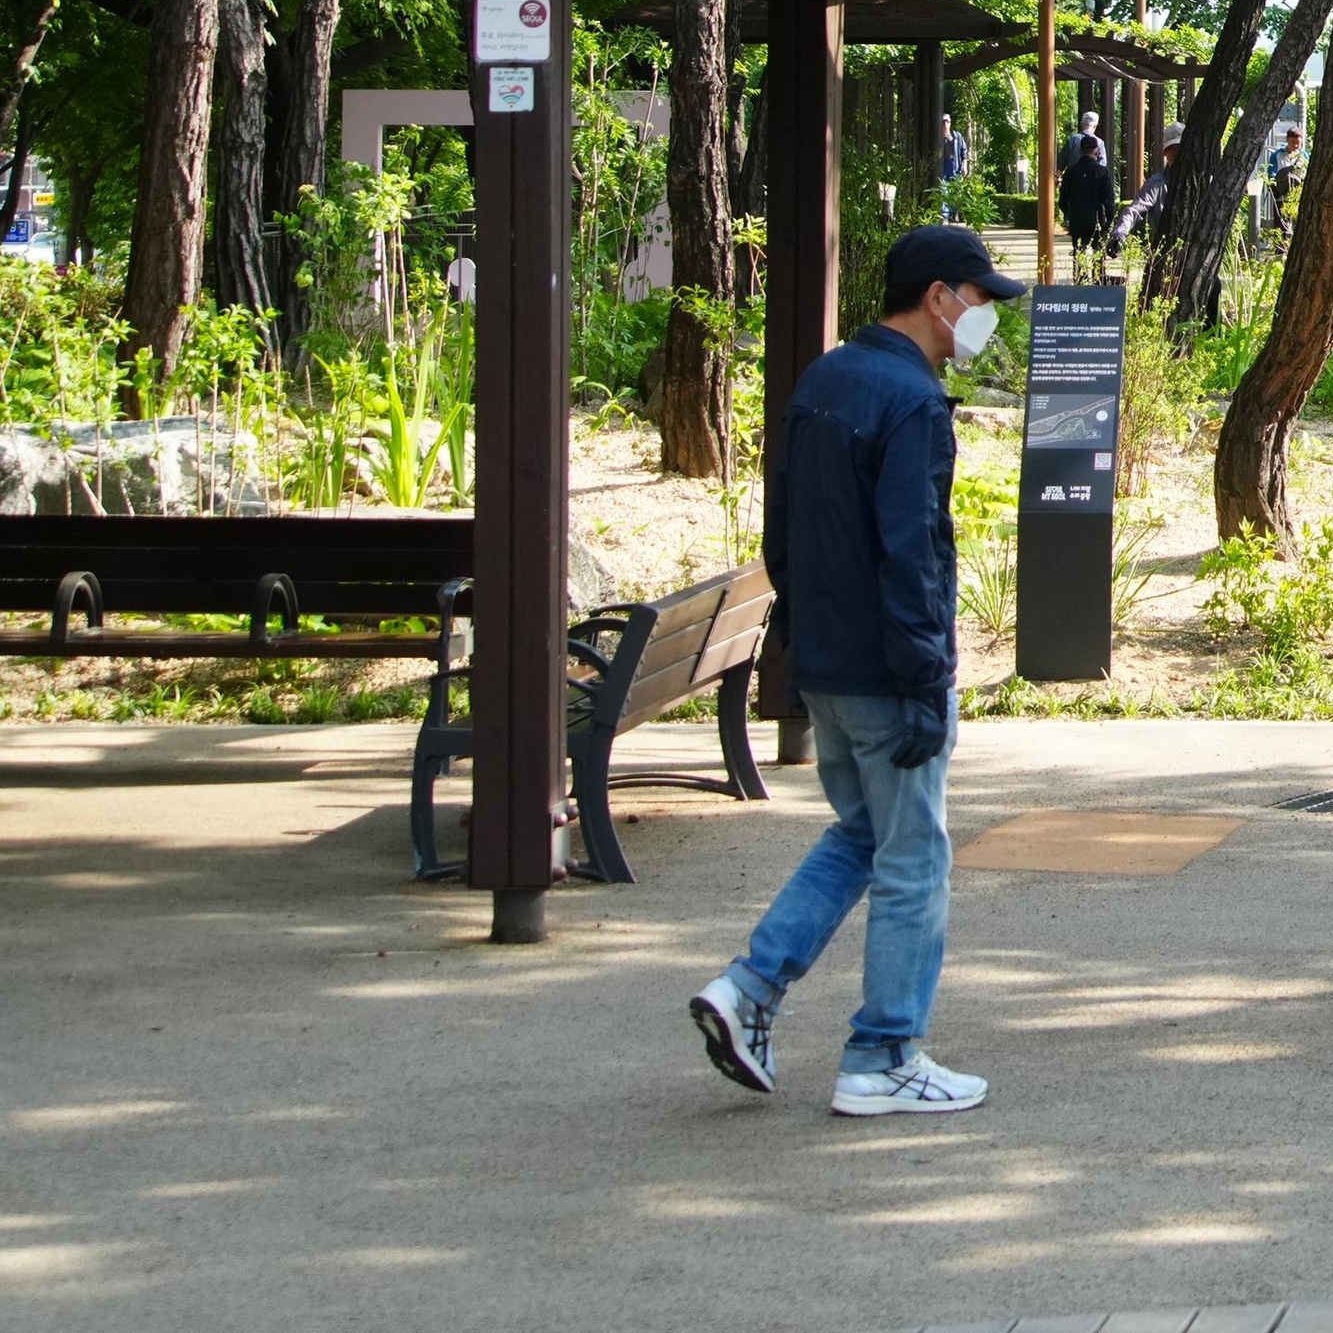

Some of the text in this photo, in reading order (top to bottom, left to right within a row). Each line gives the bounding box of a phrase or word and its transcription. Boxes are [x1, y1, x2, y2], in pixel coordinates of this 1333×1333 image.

[1036, 303, 1070, 313] 기다림의
[1071, 303, 1088, 313] 정원
[1045, 485, 1063, 494] SEOUL
